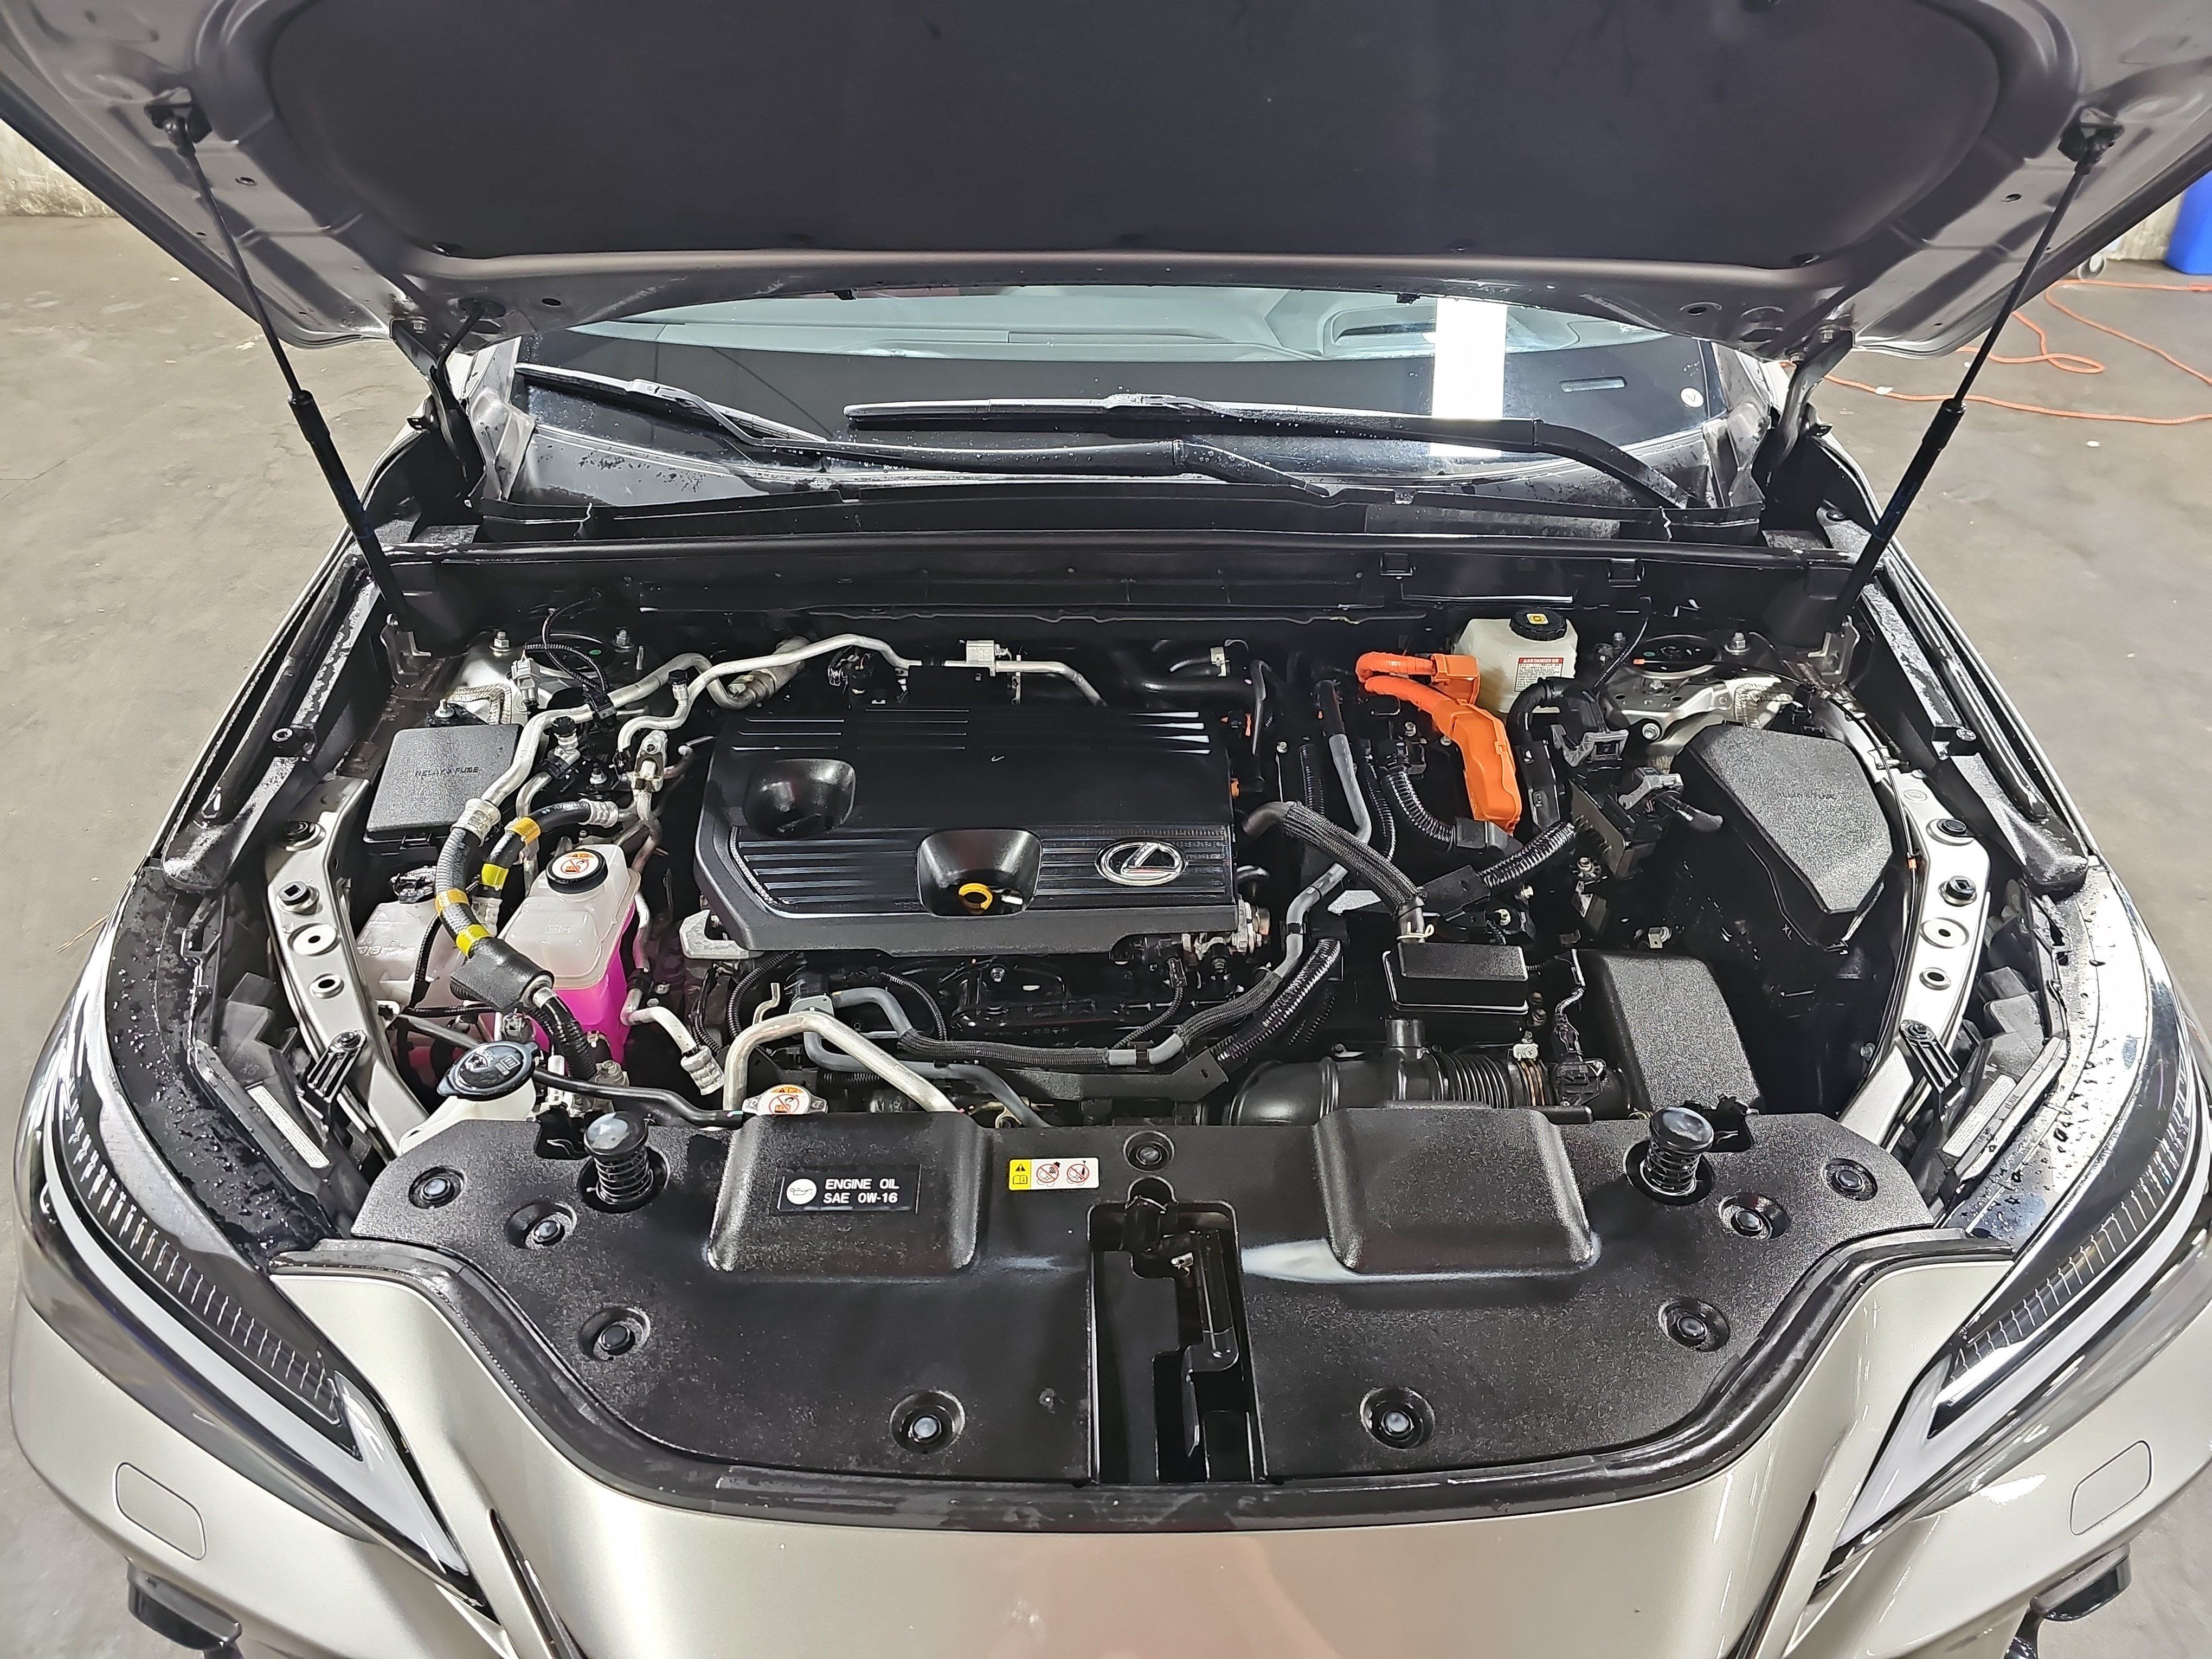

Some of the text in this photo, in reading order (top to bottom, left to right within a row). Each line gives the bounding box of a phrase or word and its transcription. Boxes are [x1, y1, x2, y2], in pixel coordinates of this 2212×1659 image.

[415, 768, 446, 777] RELAY
[454, 767, 480, 775] FUSE
[825, 1178, 900, 1190] ENGINE OIL
[823, 1192, 898, 1204] SAE 0W-16
